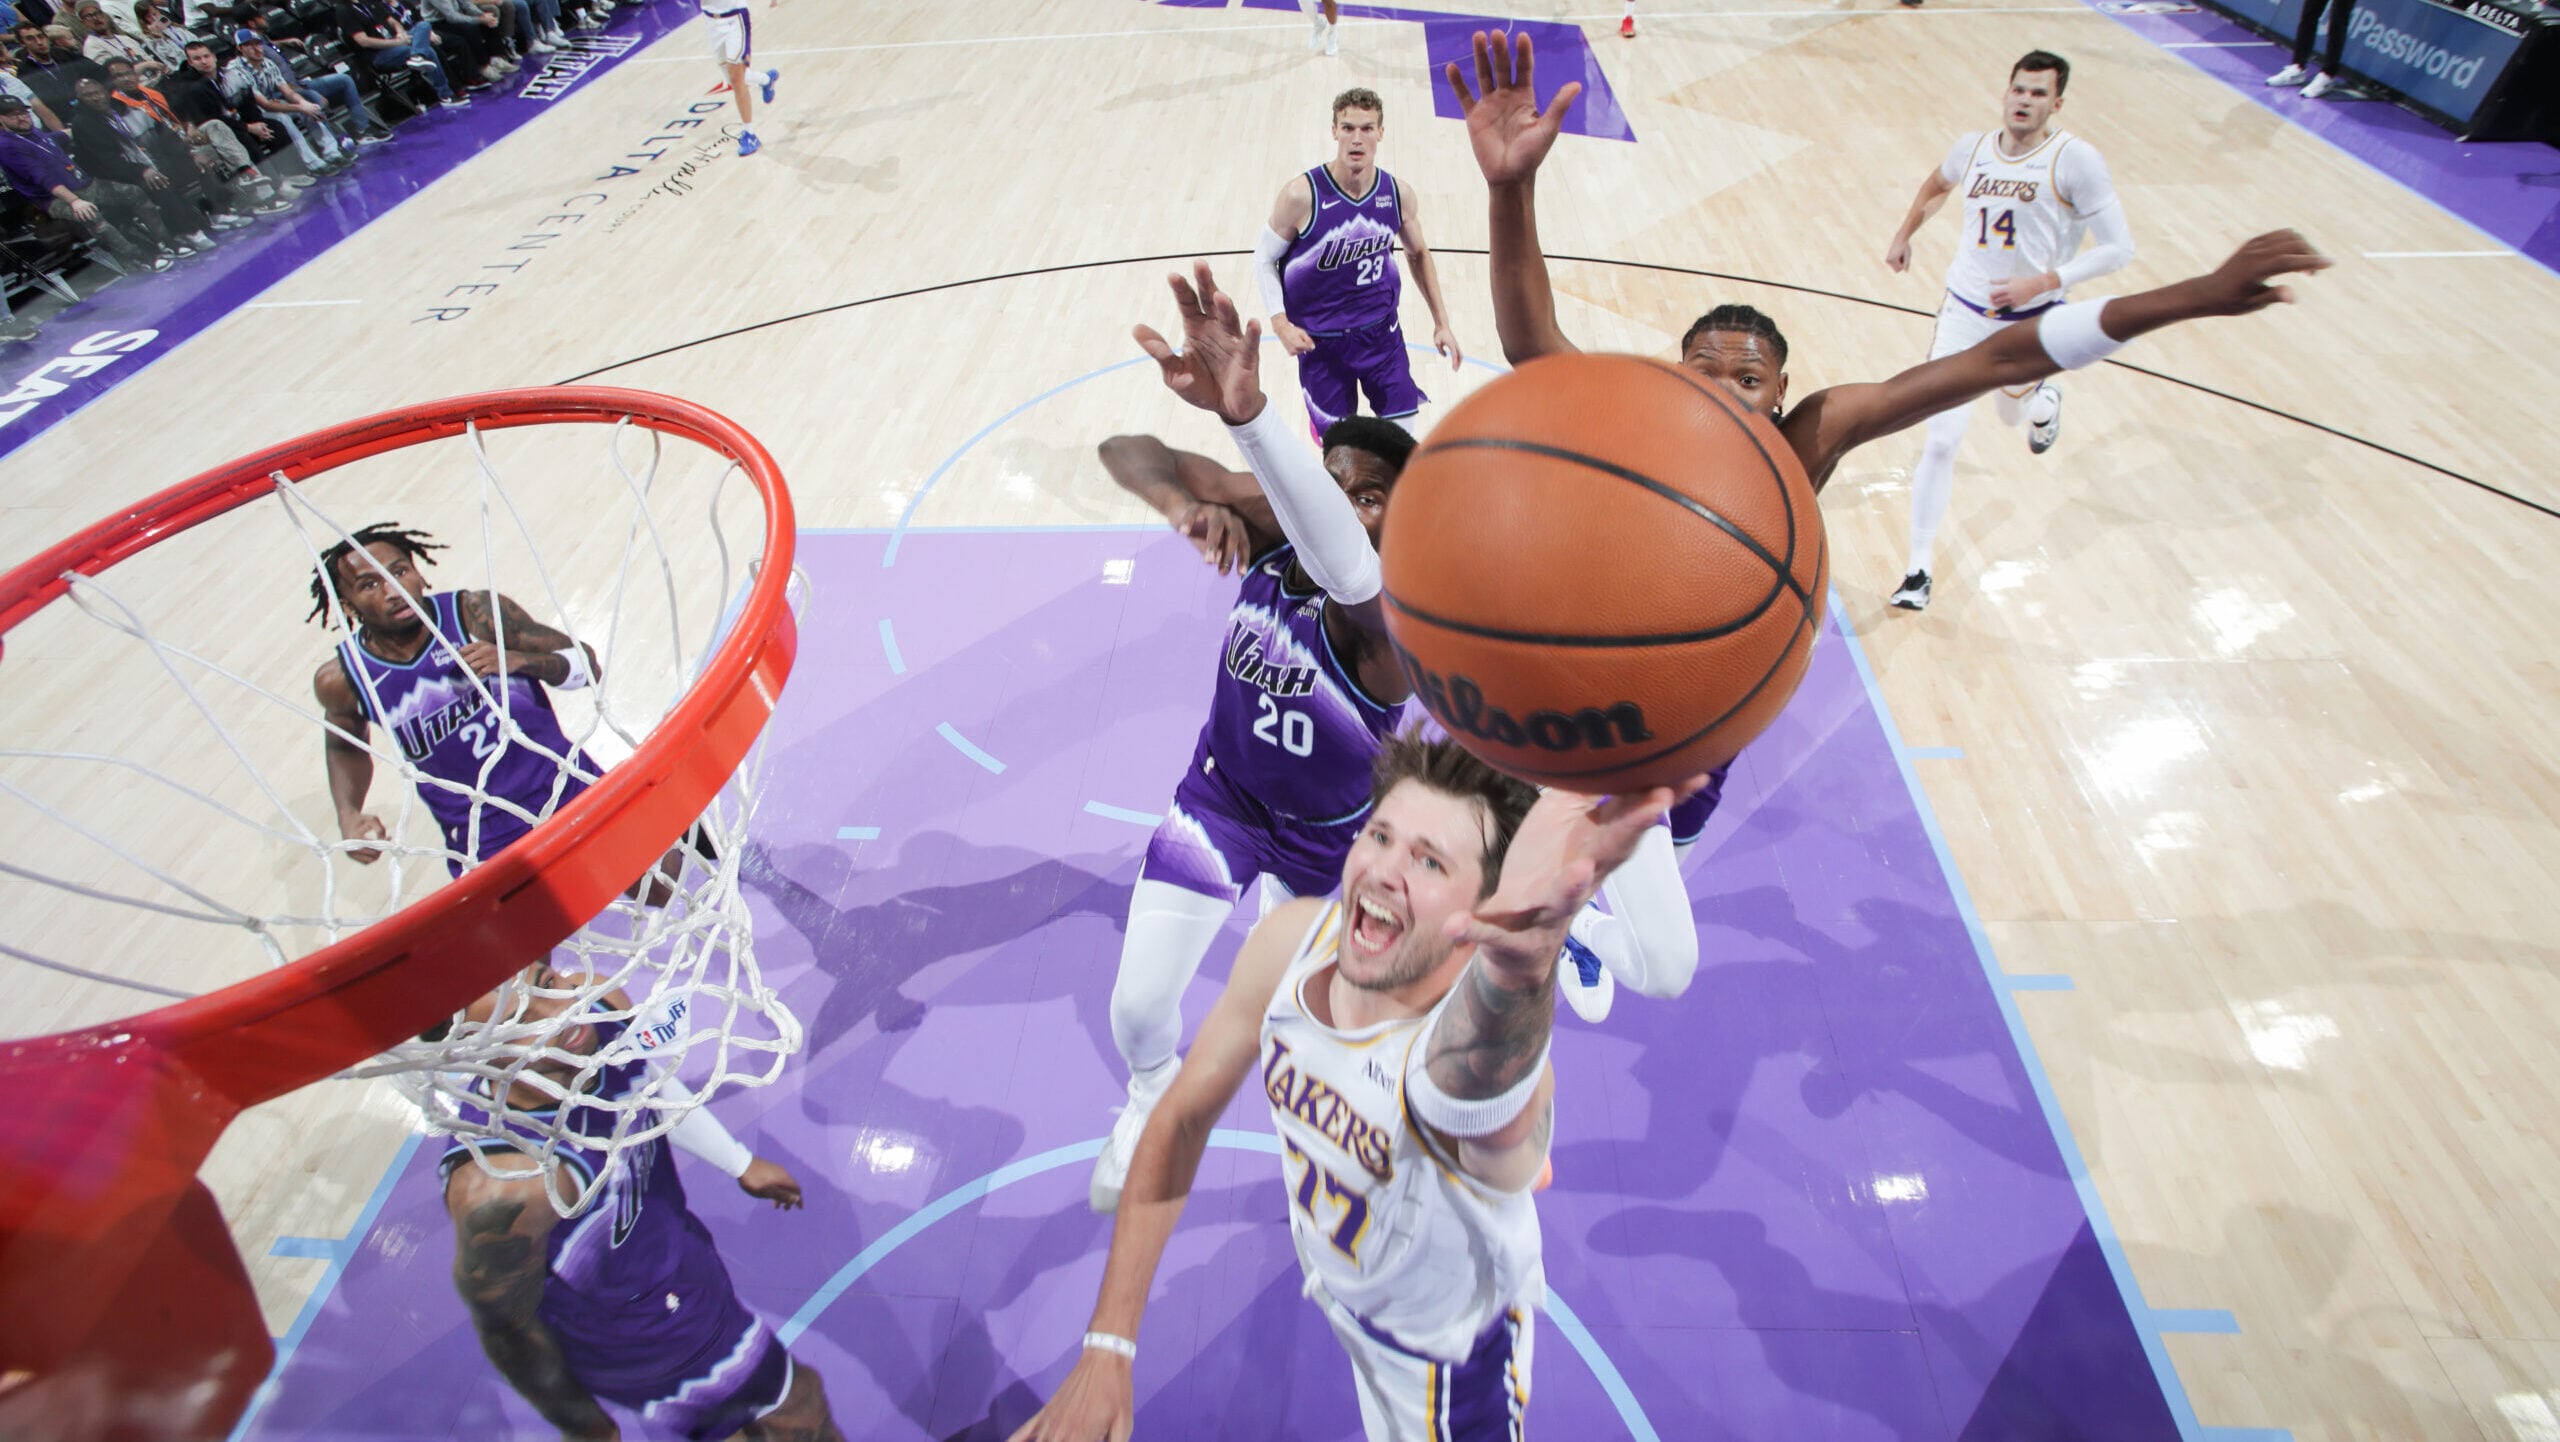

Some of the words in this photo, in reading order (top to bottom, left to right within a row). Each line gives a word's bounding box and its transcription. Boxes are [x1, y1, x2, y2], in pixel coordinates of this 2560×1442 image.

[2349, 6, 2486, 90] 1Password
[2477, 4, 2521, 29] DELTA
[519, 33, 642, 100] UTAH
[595, 101, 726, 181] DELTA
[1967, 173, 2039, 202] LAKERS
[410, 193, 607, 323] CENTER
[1317, 233, 1392, 271] UTAH
[1977, 207, 2016, 250] 14
[1356, 255, 1385, 286] 23
[1296, 605, 1319, 621] quity
[1226, 619, 1322, 697] UTAH
[460, 711, 522, 760] 2
[1253, 693, 1314, 757] 20
[1264, 1035, 1394, 1187] LAKERS
[1284, 1132, 1372, 1271] 77
